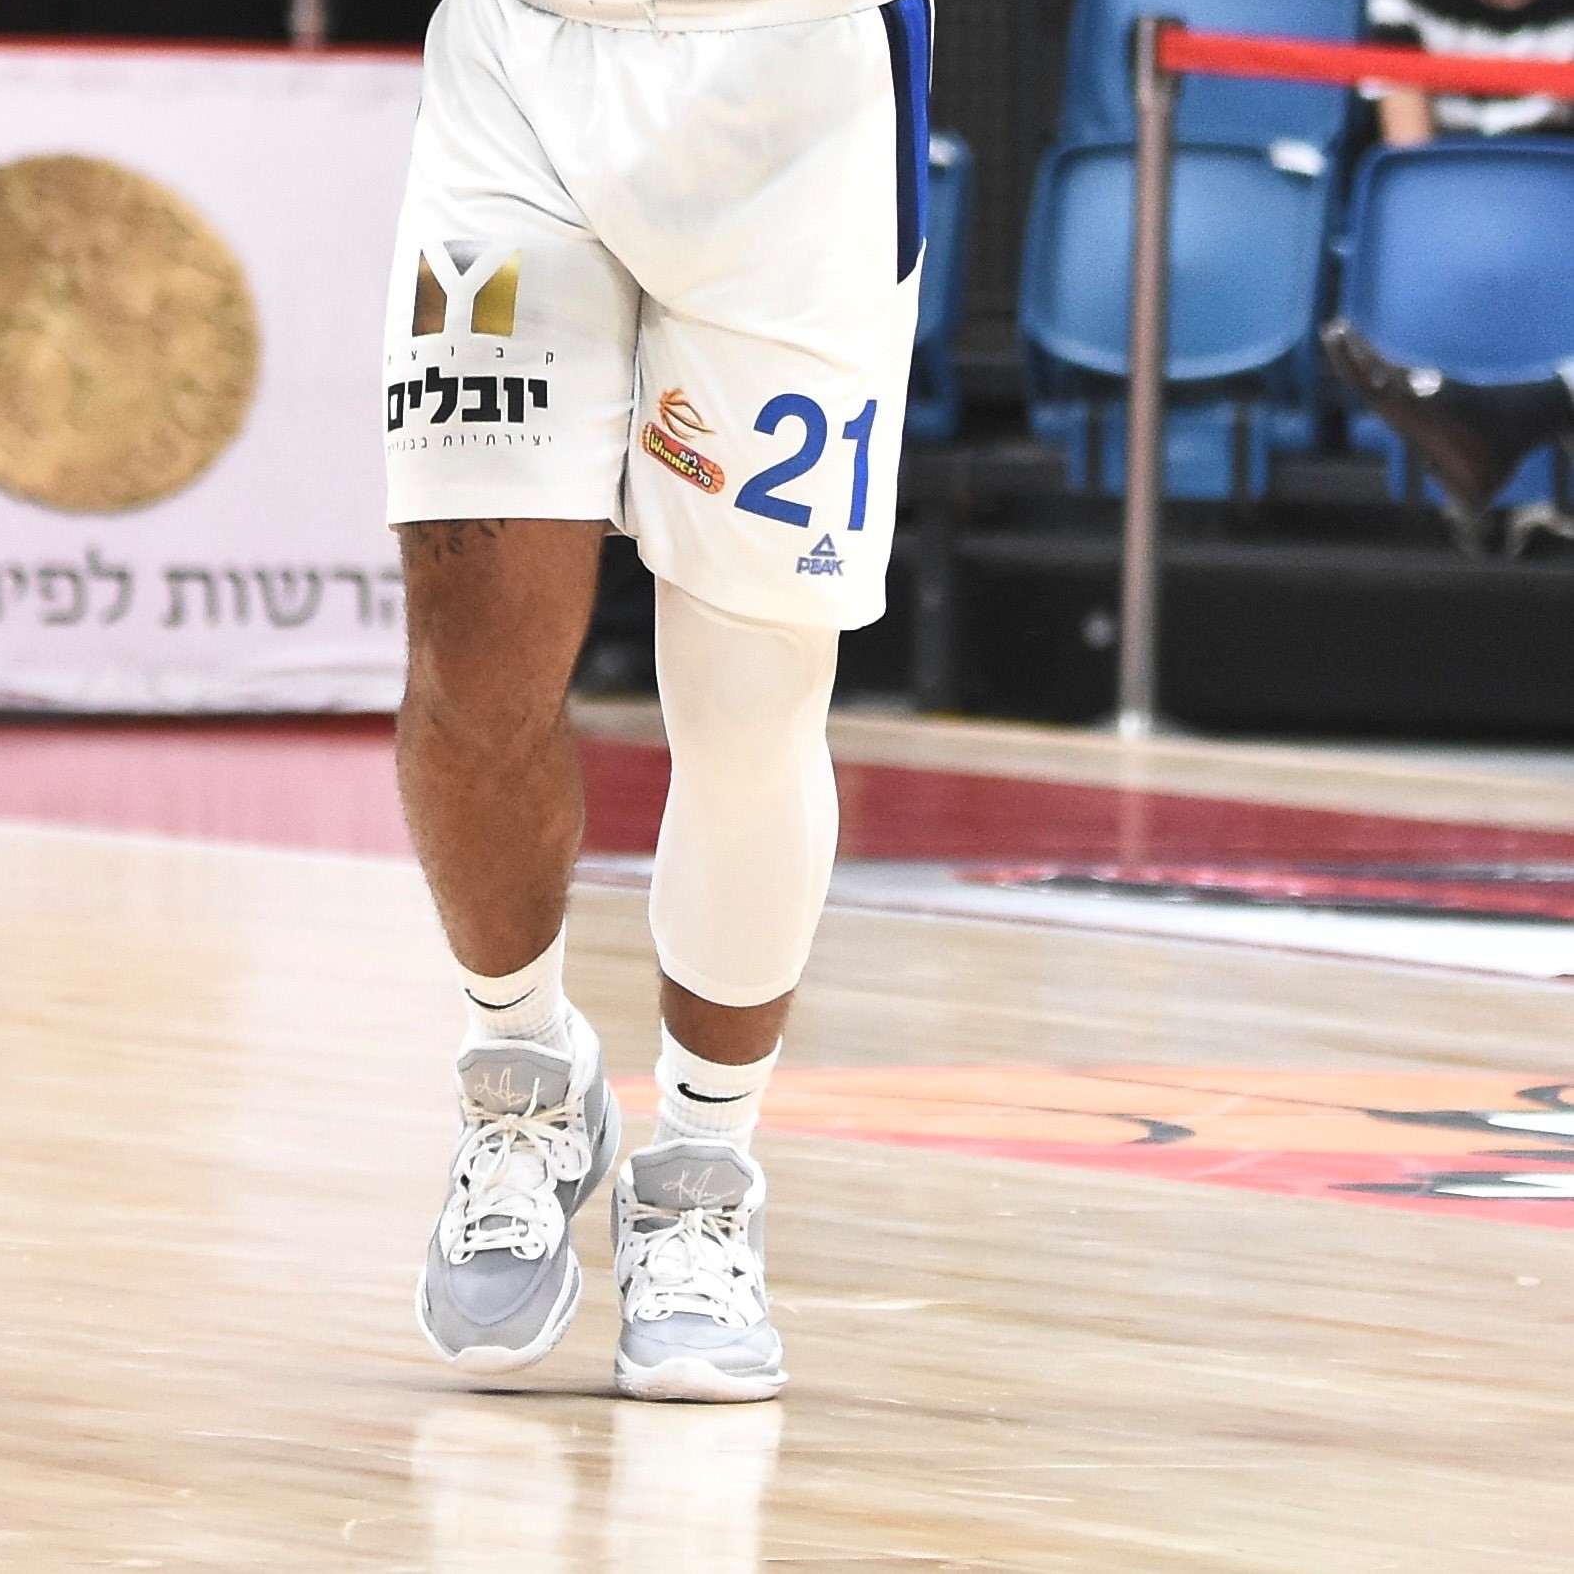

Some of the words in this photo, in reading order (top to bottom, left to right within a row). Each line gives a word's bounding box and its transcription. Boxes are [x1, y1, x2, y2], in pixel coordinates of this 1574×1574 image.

[388, 366, 548, 432] יובלים
[649, 431, 697, 476] Winner
[734, 393, 878, 531] 21
[795, 556, 845, 576] PEAK
